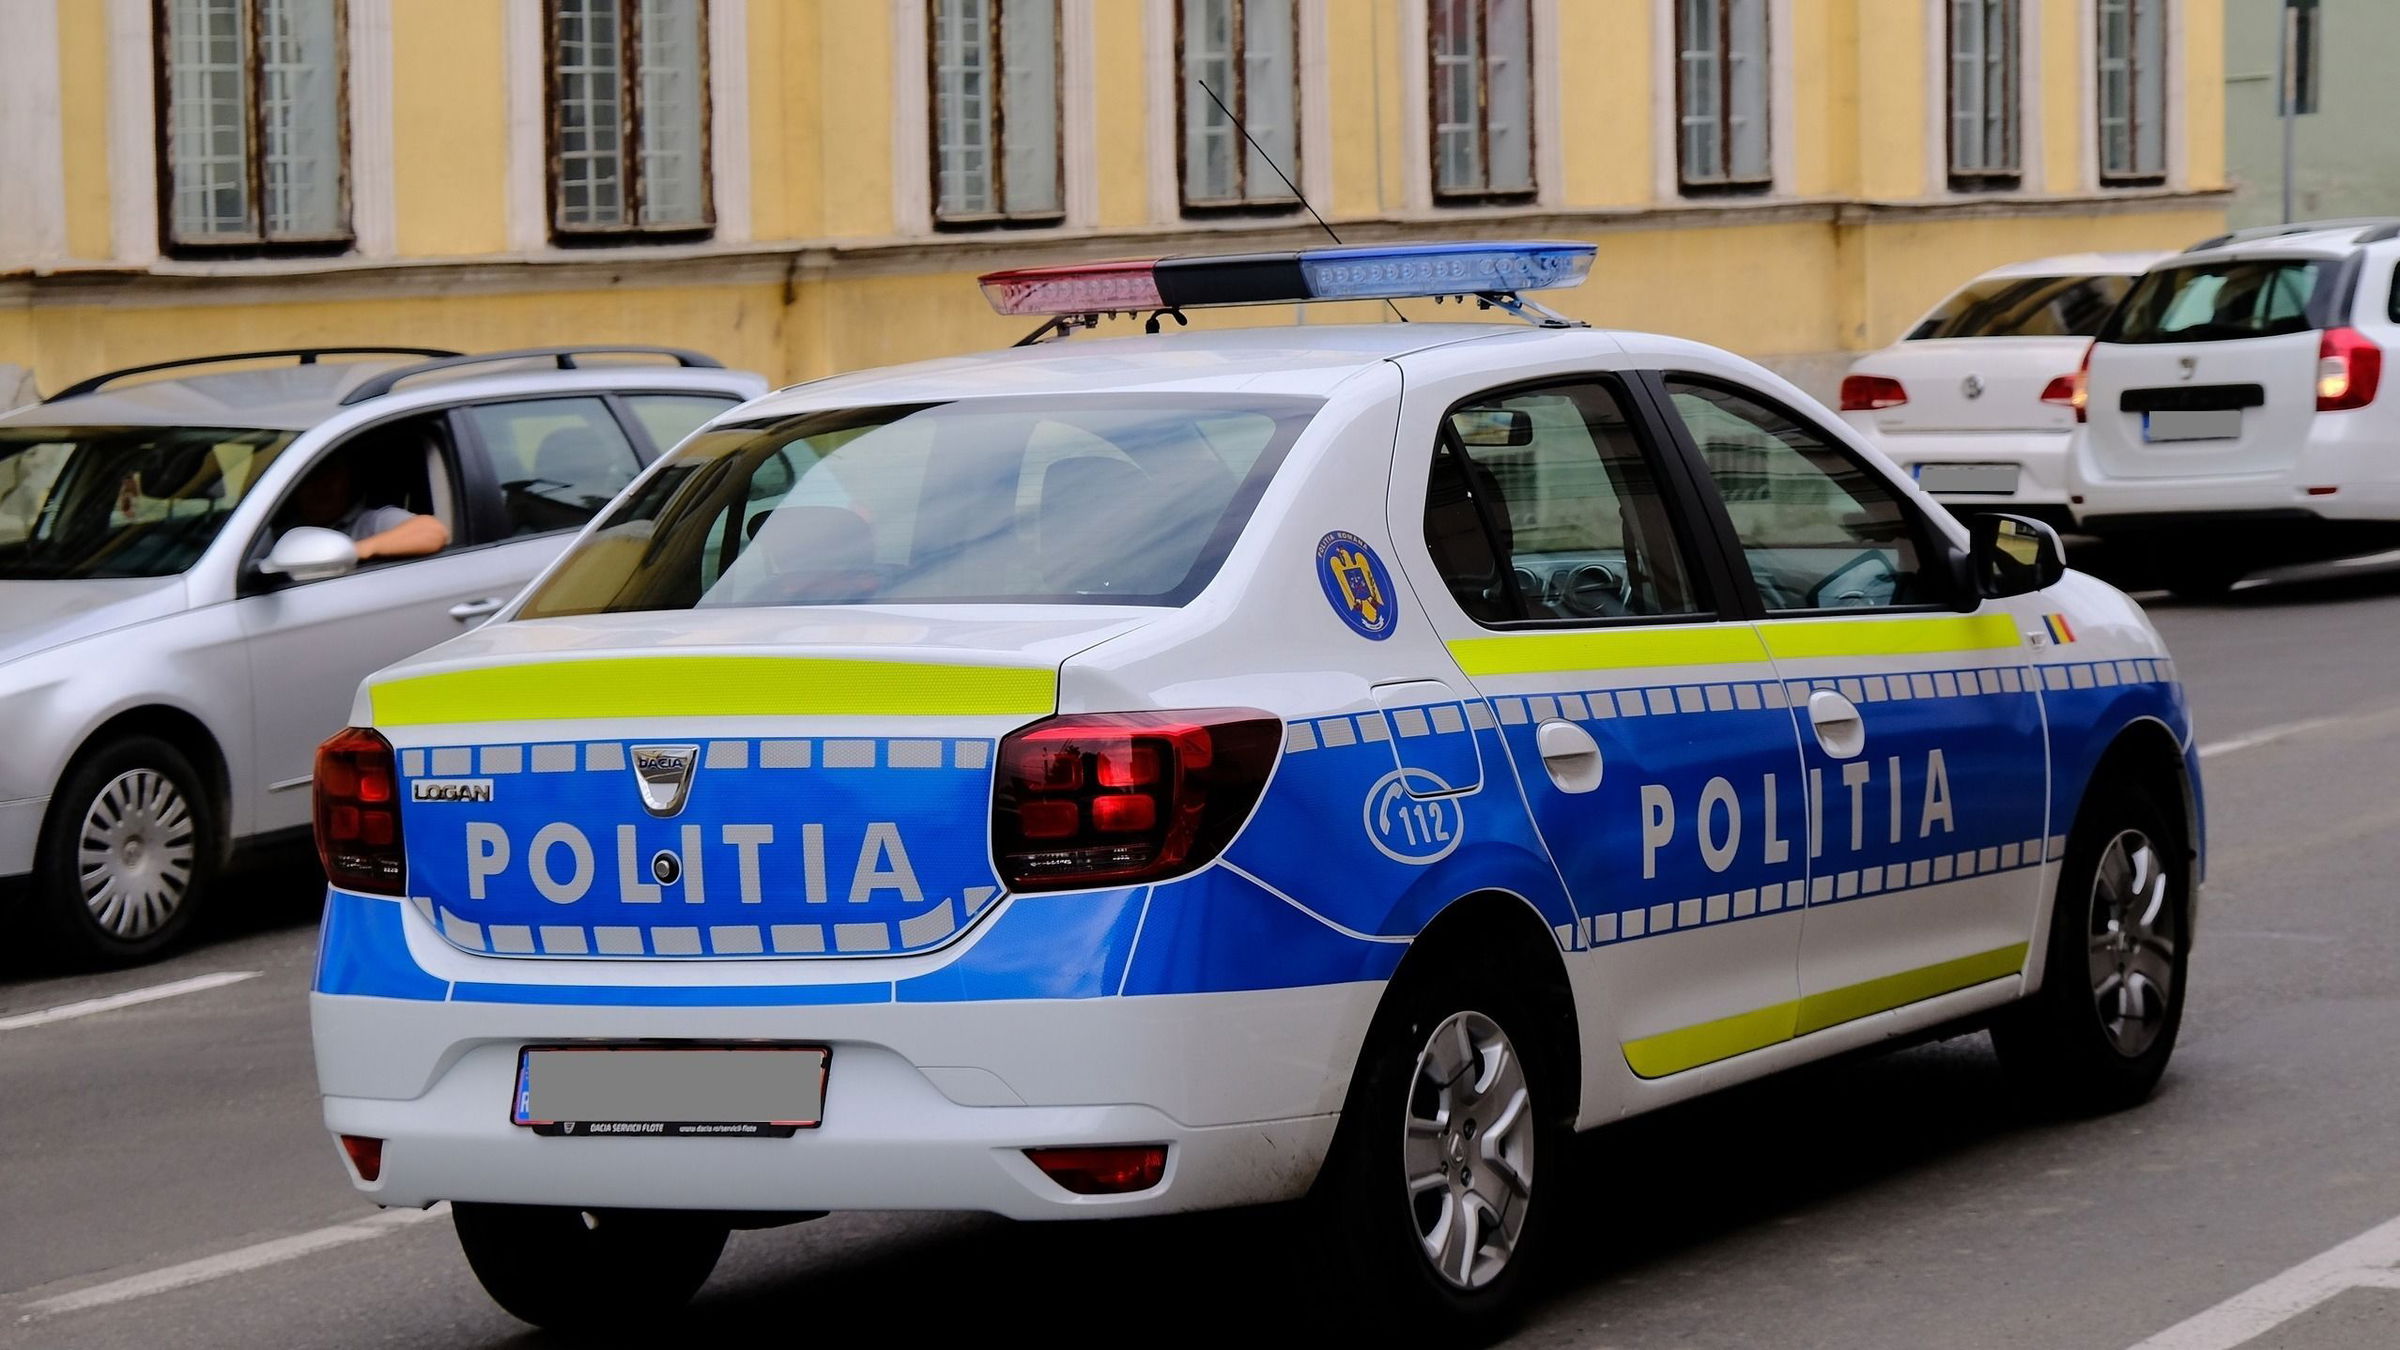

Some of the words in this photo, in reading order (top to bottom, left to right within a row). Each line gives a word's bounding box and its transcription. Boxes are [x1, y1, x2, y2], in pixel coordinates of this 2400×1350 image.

[638, 758, 683, 769] DACIA
[414, 784, 491, 802] LOGAN
[1399, 801, 1450, 846] 112
[1640, 749, 1954, 879] POLITIA
[466, 821, 925, 904] POLITIA
[590, 1122, 612, 1132] DACIA
[612, 1122, 642, 1132] SERVICII
[642, 1122, 665, 1132] FLOTE
